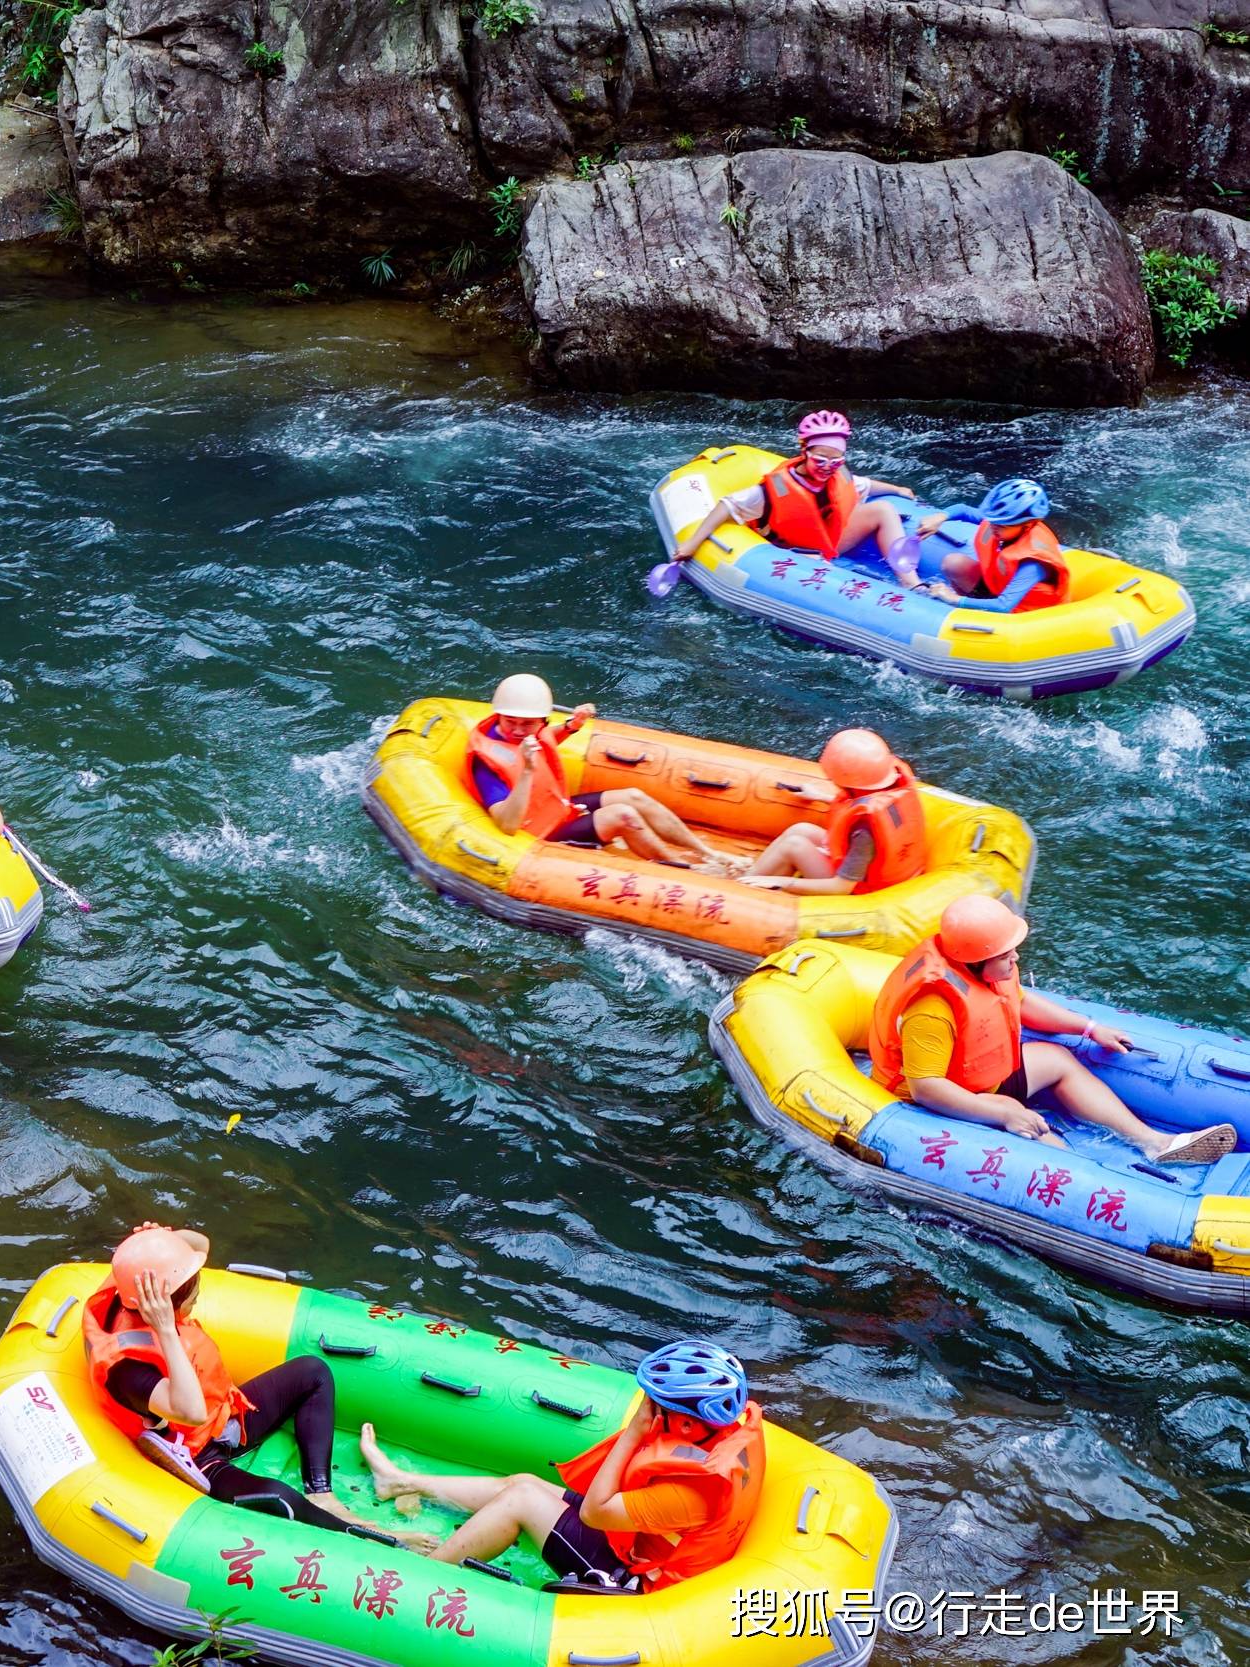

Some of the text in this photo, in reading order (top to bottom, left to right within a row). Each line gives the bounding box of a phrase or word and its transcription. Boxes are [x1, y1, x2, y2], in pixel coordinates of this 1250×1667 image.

[770, 558, 905, 612] 玄真漂流
[577, 867, 729, 925] 玄真漂流
[920, 1130, 1128, 1232] 玄真漂流
[220, 1537, 475, 1638] 玄真漂流
